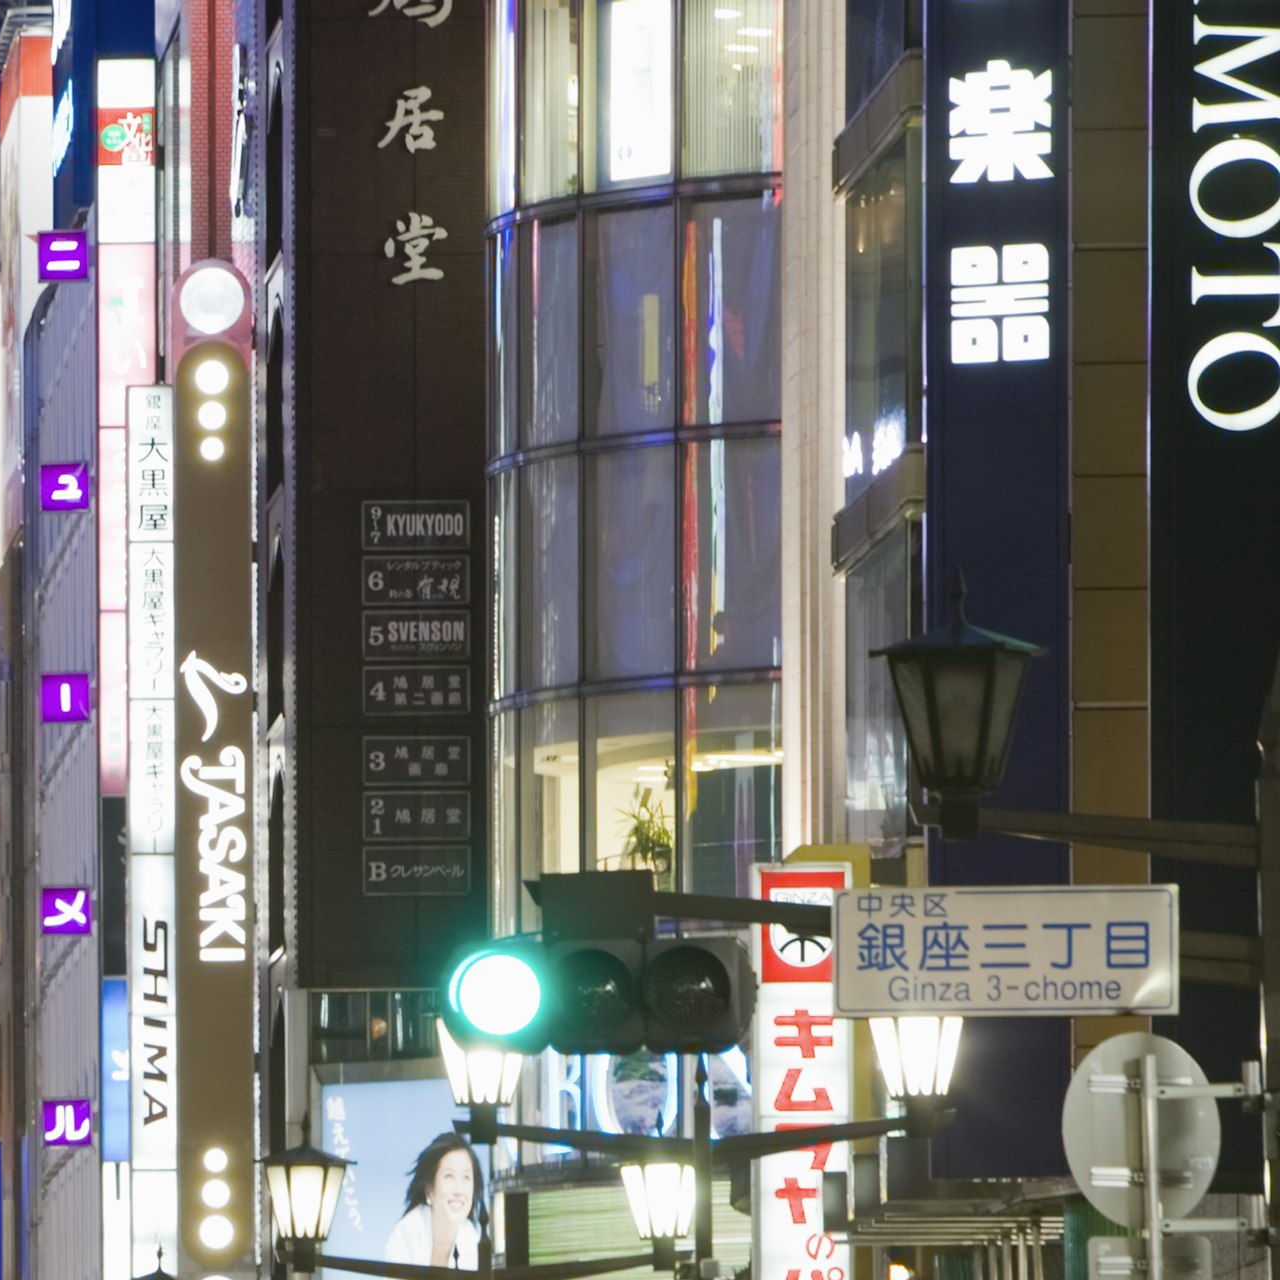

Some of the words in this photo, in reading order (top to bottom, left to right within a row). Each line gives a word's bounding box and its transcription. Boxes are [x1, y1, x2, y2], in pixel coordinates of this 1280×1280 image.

[948, 60, 1054, 364] 楽器
[1188, 0, 1280, 432] MOTO
[138, 437, 169, 531] 大黒屋
[386, 513, 464, 537] KYUKYODO
[368, 571, 384, 591] 6
[142, 547, 167, 690] 大黒屋ギャラリー
[387, 621, 464, 642] SVENSON
[368, 626, 384, 646] 5
[370, 681, 386, 701] 4
[369, 751, 386, 771] 3
[144, 705, 164, 853] 大黒屋ギャラリー
[181, 745, 246, 962] TASAKI
[368, 862, 386, 882] B
[857, 893, 949, 919] 中央区
[857, 922, 1150, 971] 銀座三丁目
[888, 975, 971, 1003] Ginza
[987, 974, 1122, 1002] 3-chome
[142, 917, 169, 1127] SHIMA
